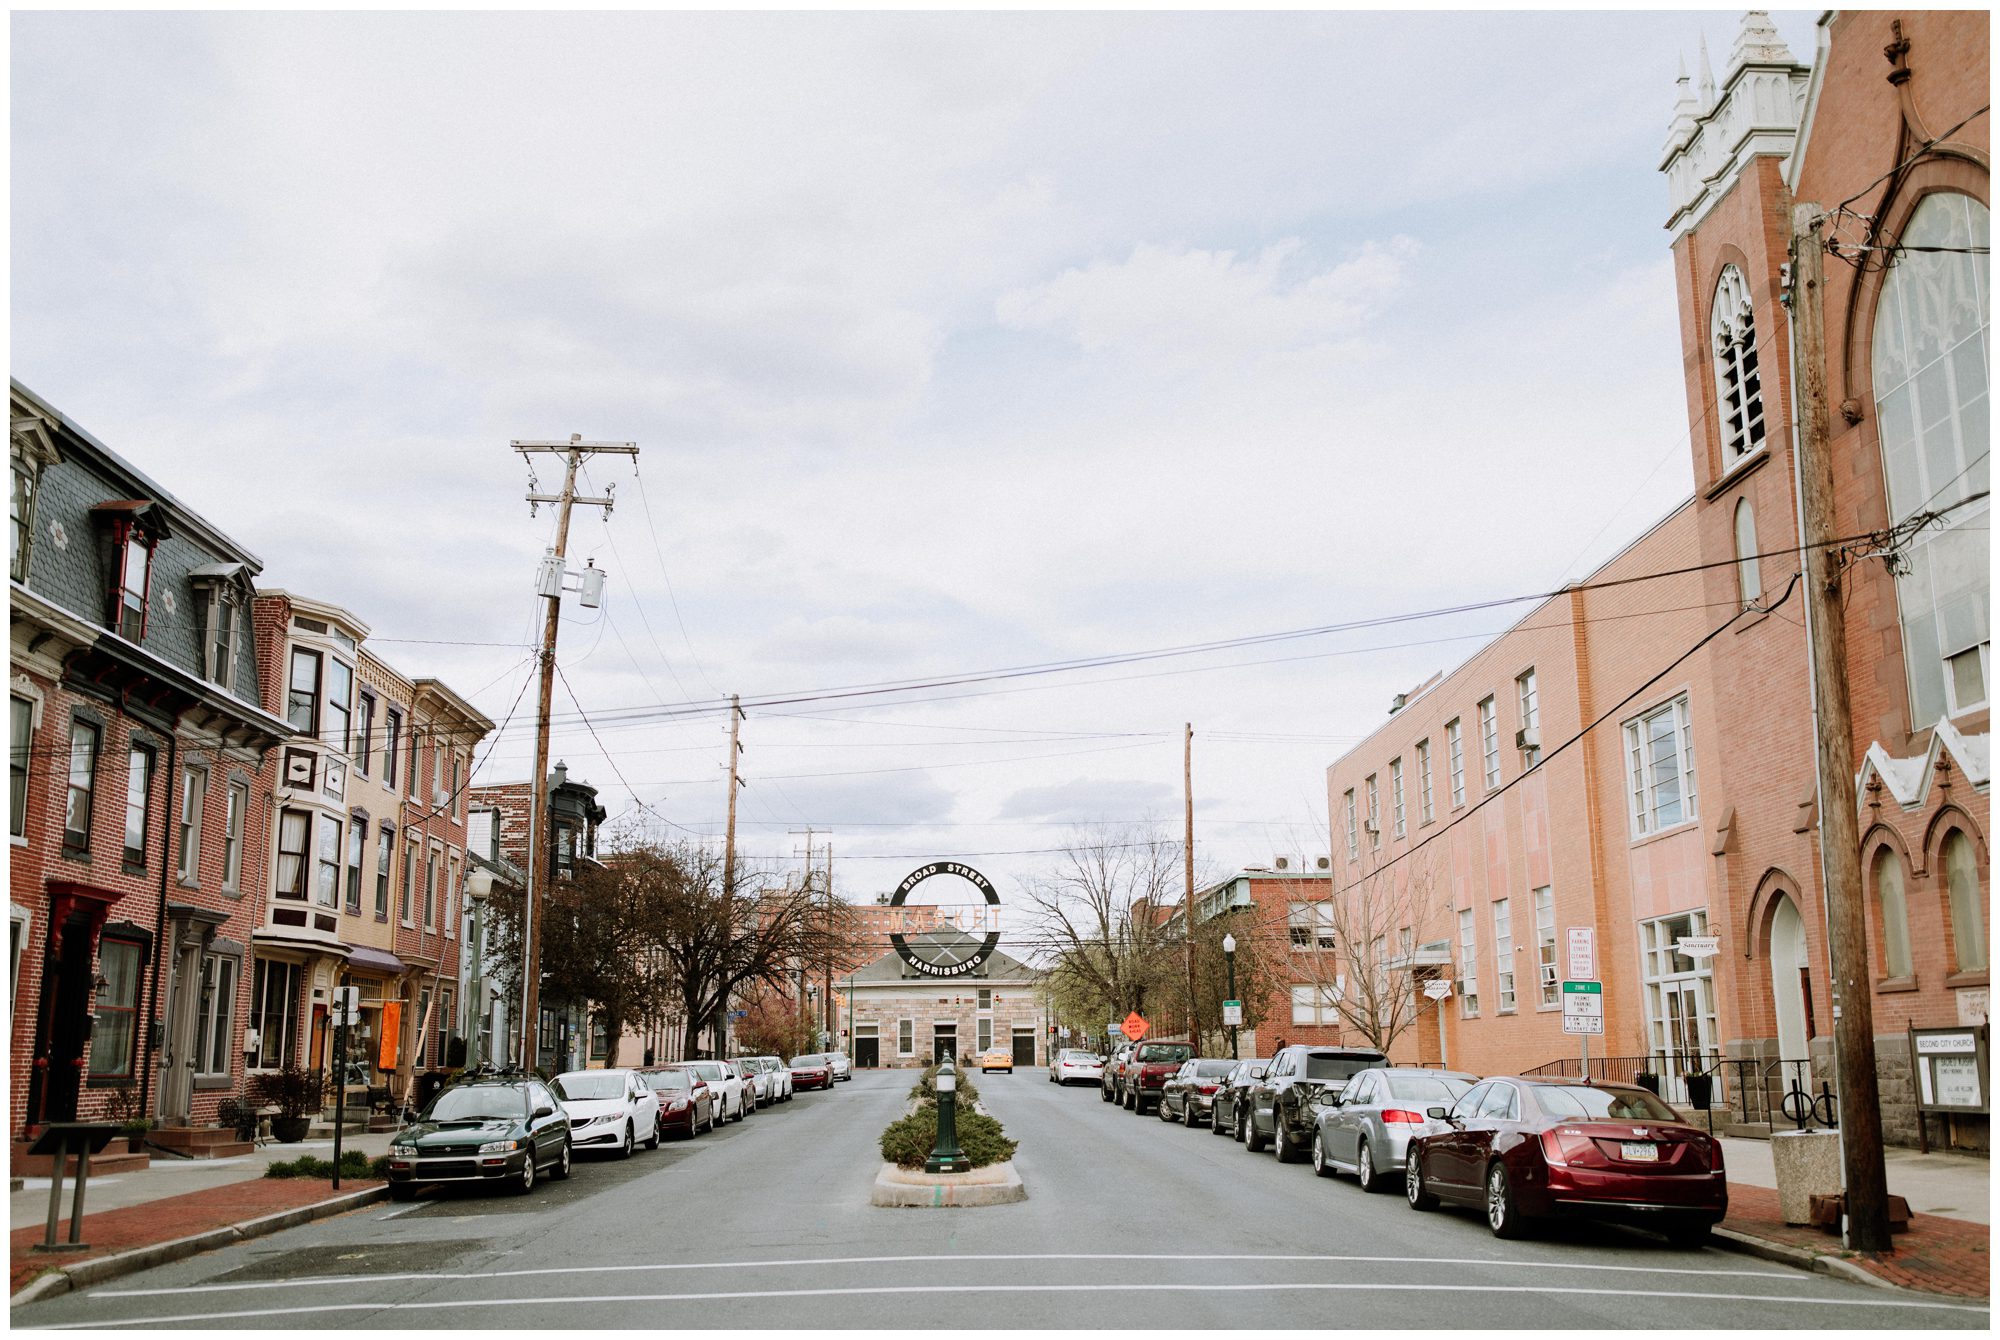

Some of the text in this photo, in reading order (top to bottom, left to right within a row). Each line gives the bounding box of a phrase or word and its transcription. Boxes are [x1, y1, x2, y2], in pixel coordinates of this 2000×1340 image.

[902, 864, 989, 891] BROAD STREET
[890, 908, 1001, 929] MARKET
[908, 956, 981, 976] HARRISBURG
[1920, 1039, 1973, 1048] SECOND CITY CHURCH
